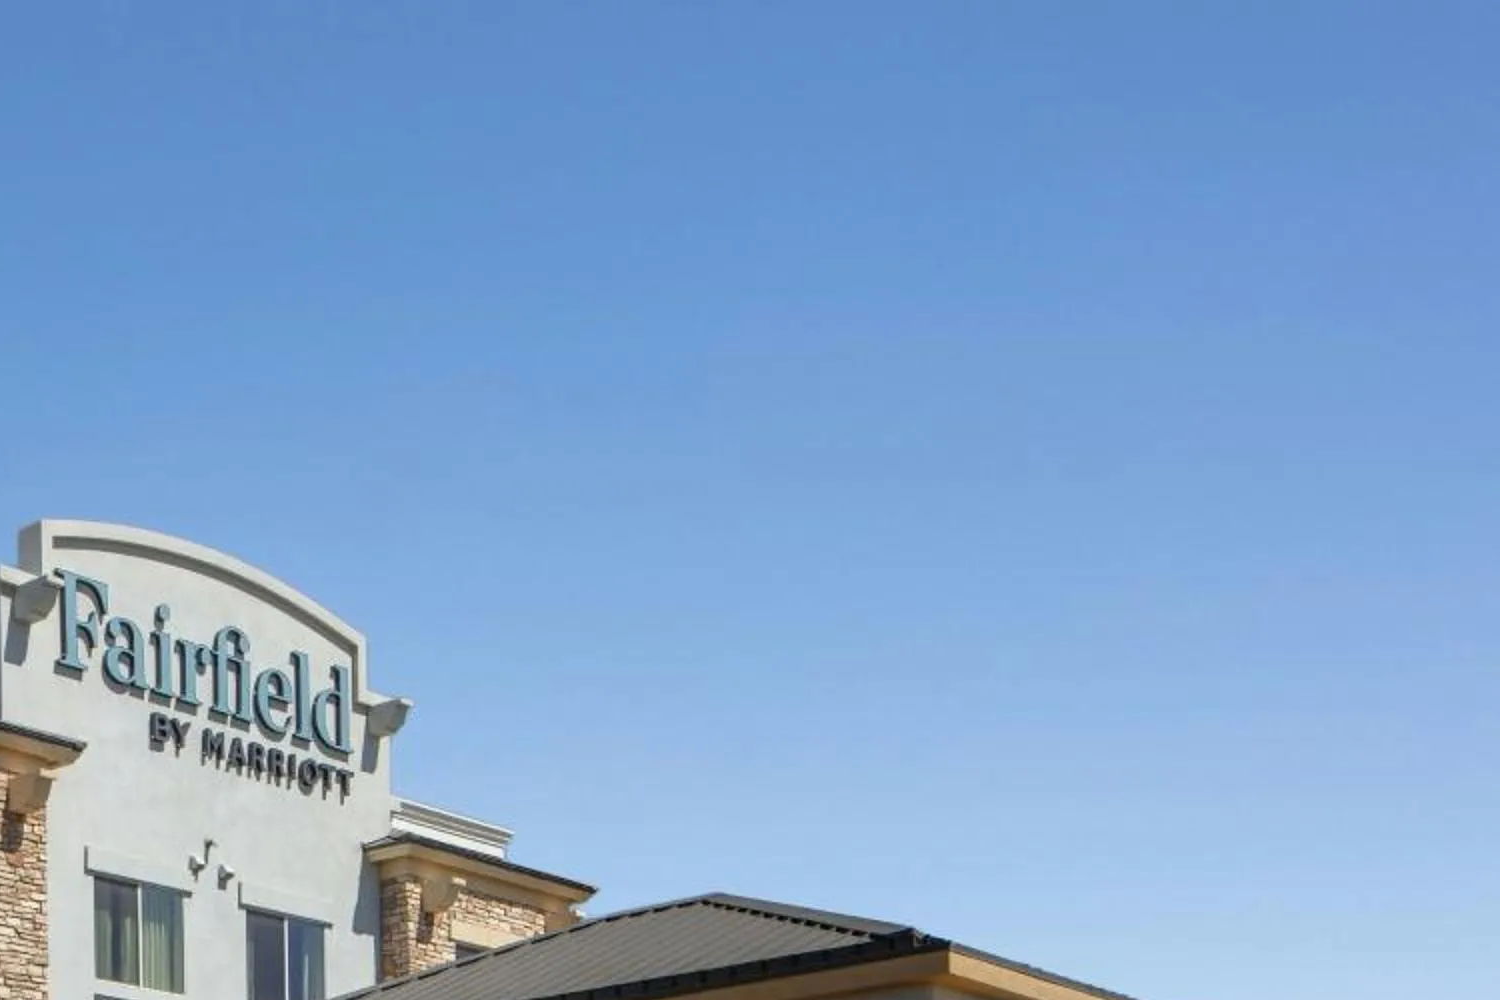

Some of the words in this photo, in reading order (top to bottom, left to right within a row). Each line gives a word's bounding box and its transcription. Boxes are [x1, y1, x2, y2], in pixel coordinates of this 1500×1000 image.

[54, 568, 353, 754] Fairfield
[150, 711, 191, 751] BY
[202, 728, 354, 798] MARRIOTT
